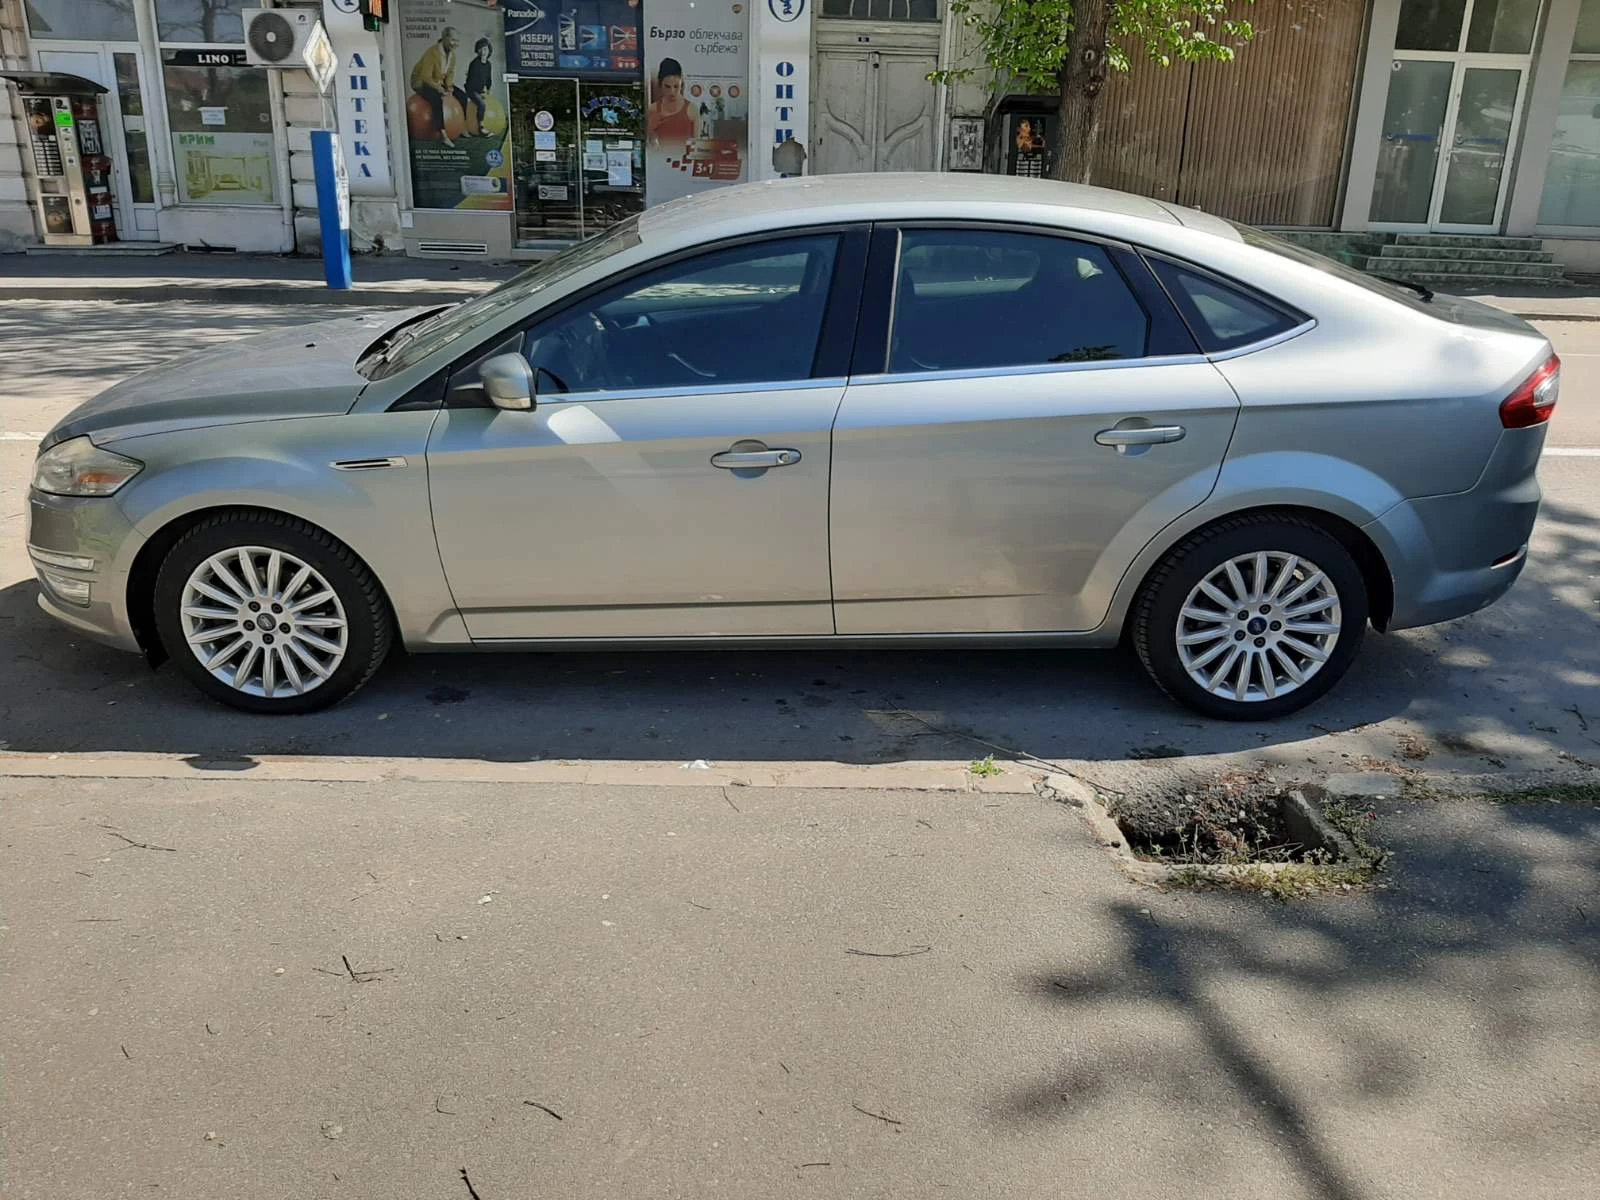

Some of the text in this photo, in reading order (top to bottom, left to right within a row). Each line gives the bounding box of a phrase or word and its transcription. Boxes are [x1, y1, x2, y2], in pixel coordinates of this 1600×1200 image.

[508, 9, 537, 18] Panadol
[520, 33, 554, 43] ИЗБЕРИ
[650, 26, 743, 41] Бързо облекчава
[694, 42, 739, 55] сърбежа
[197, 54, 229, 64] LINO
[349, 53, 373, 178] АПТЕКА
